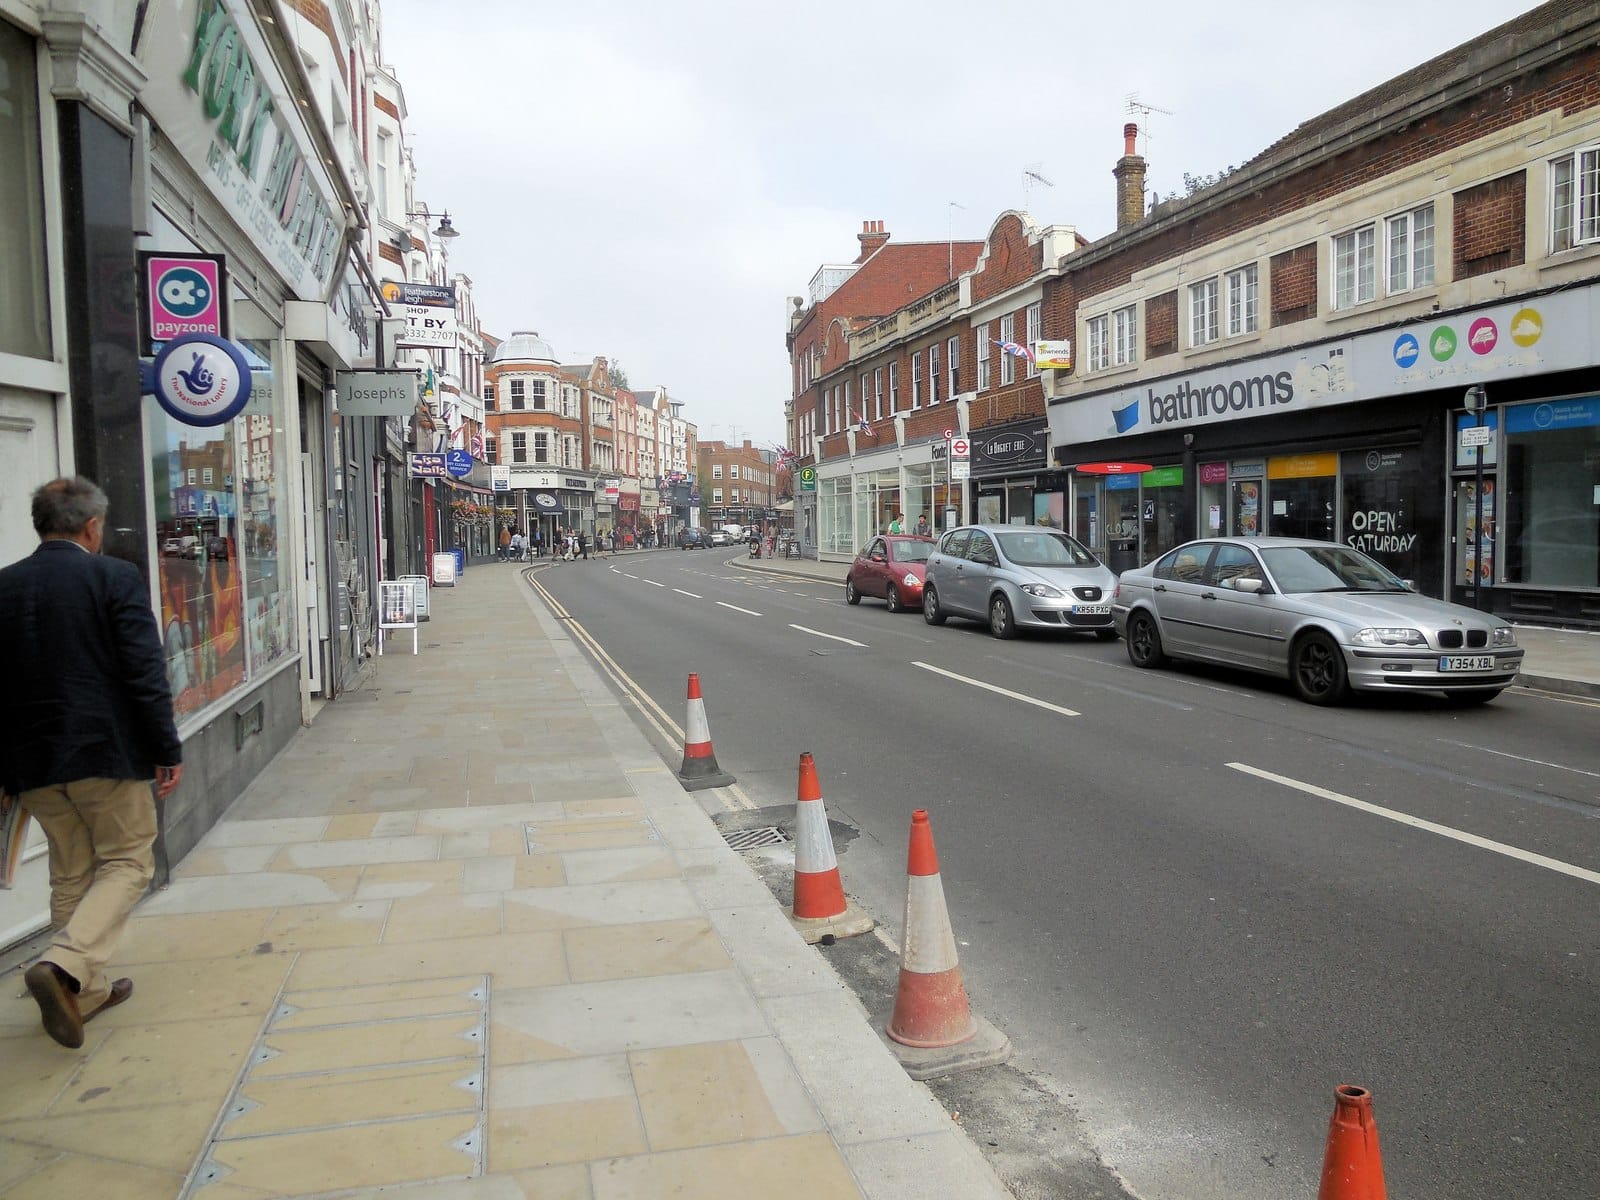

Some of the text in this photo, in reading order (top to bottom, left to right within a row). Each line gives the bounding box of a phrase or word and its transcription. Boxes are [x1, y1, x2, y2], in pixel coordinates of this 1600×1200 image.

[404, 287, 449, 299] featherstone
[404, 295, 423, 305] leigh
[406, 307, 429, 315] SHOP
[156, 322, 216, 336] payzone
[424, 319, 447, 329] BY
[431, 331, 453, 341] 2707
[171, 376, 179, 390] The
[176, 389, 211, 408] National
[209, 377, 229, 404] Lottery
[347, 386, 406, 406] Joseph's
[1149, 372, 1293, 425] bathrooms
[944, 429, 952, 438] G
[931, 445, 947, 460] Foxto
[412, 455, 441, 464] Lisa
[541, 477, 549, 485] 21
[1352, 510, 1396, 532] OPEN
[1347, 533, 1417, 553] SATURDAY
[1077, 606, 1095, 614] KR56
[1449, 657, 1494, 669] Y354 XBL
